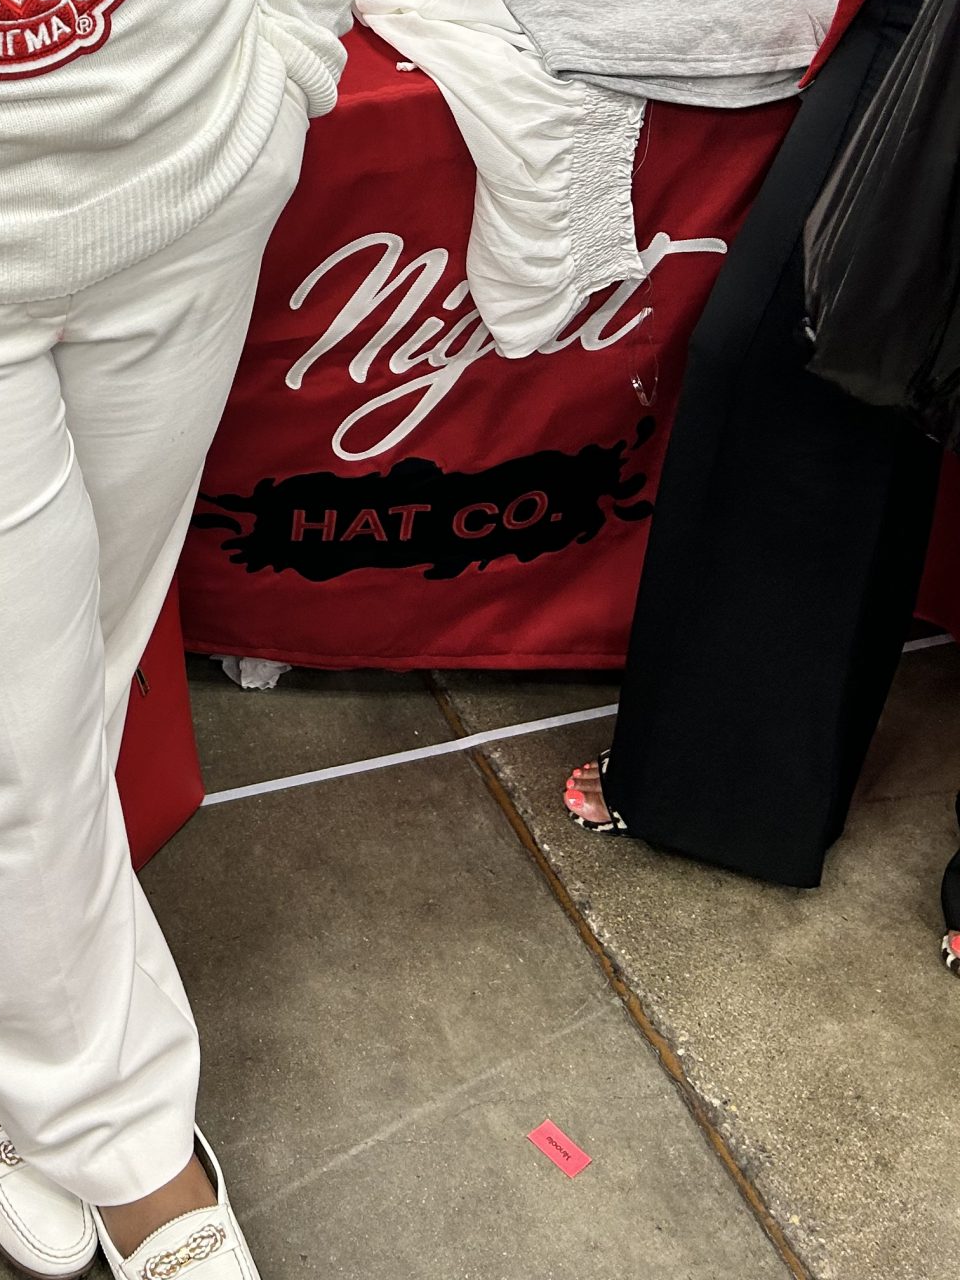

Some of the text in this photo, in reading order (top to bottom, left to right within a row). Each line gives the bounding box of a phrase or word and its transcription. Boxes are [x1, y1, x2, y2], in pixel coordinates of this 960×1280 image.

[285, 231, 728, 461] Nigt
[289, 490, 563, 543] HAT CO.
